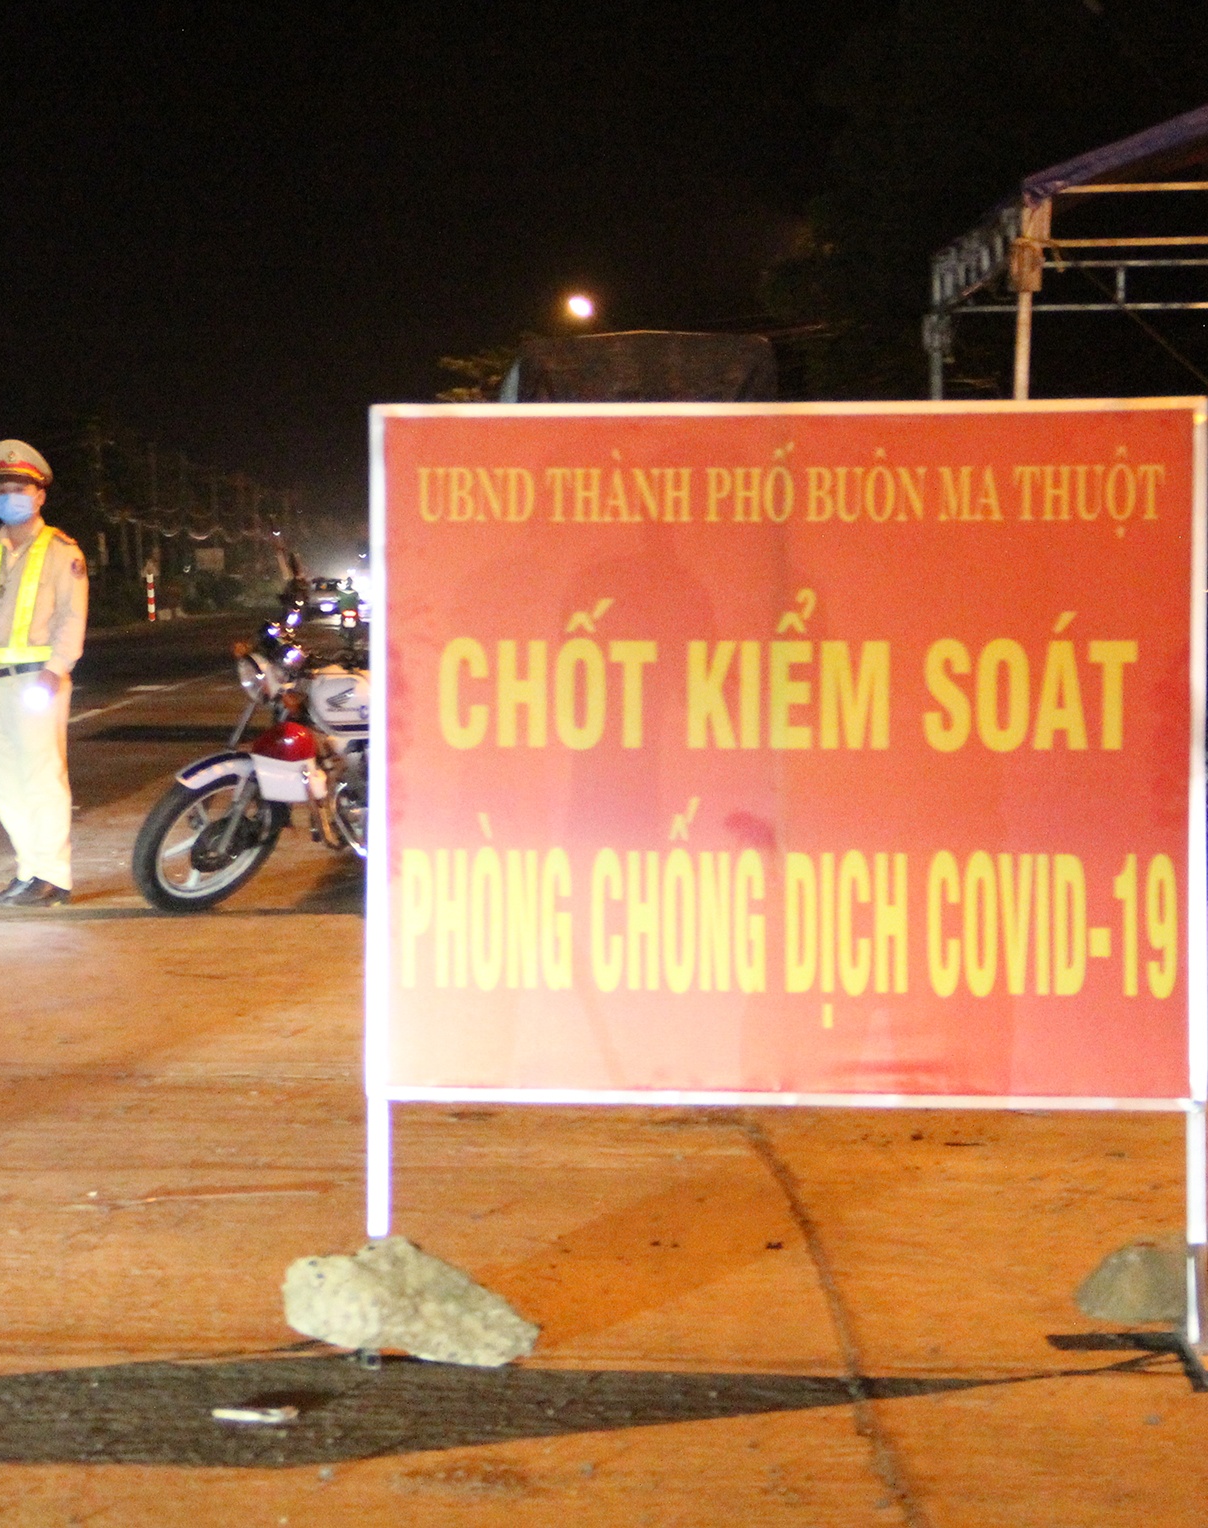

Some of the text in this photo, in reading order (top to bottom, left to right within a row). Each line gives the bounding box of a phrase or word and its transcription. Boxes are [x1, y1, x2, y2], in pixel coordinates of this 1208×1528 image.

[417, 441, 1166, 538] UBND THÀNH PHỐ BUÔN MA THUỘT
[438, 588, 1140, 753] CHỐT KIỂM SOÁT
[400, 796, 1178, 1029] PHÒNG CHỐNG DỊCH COVID-19
